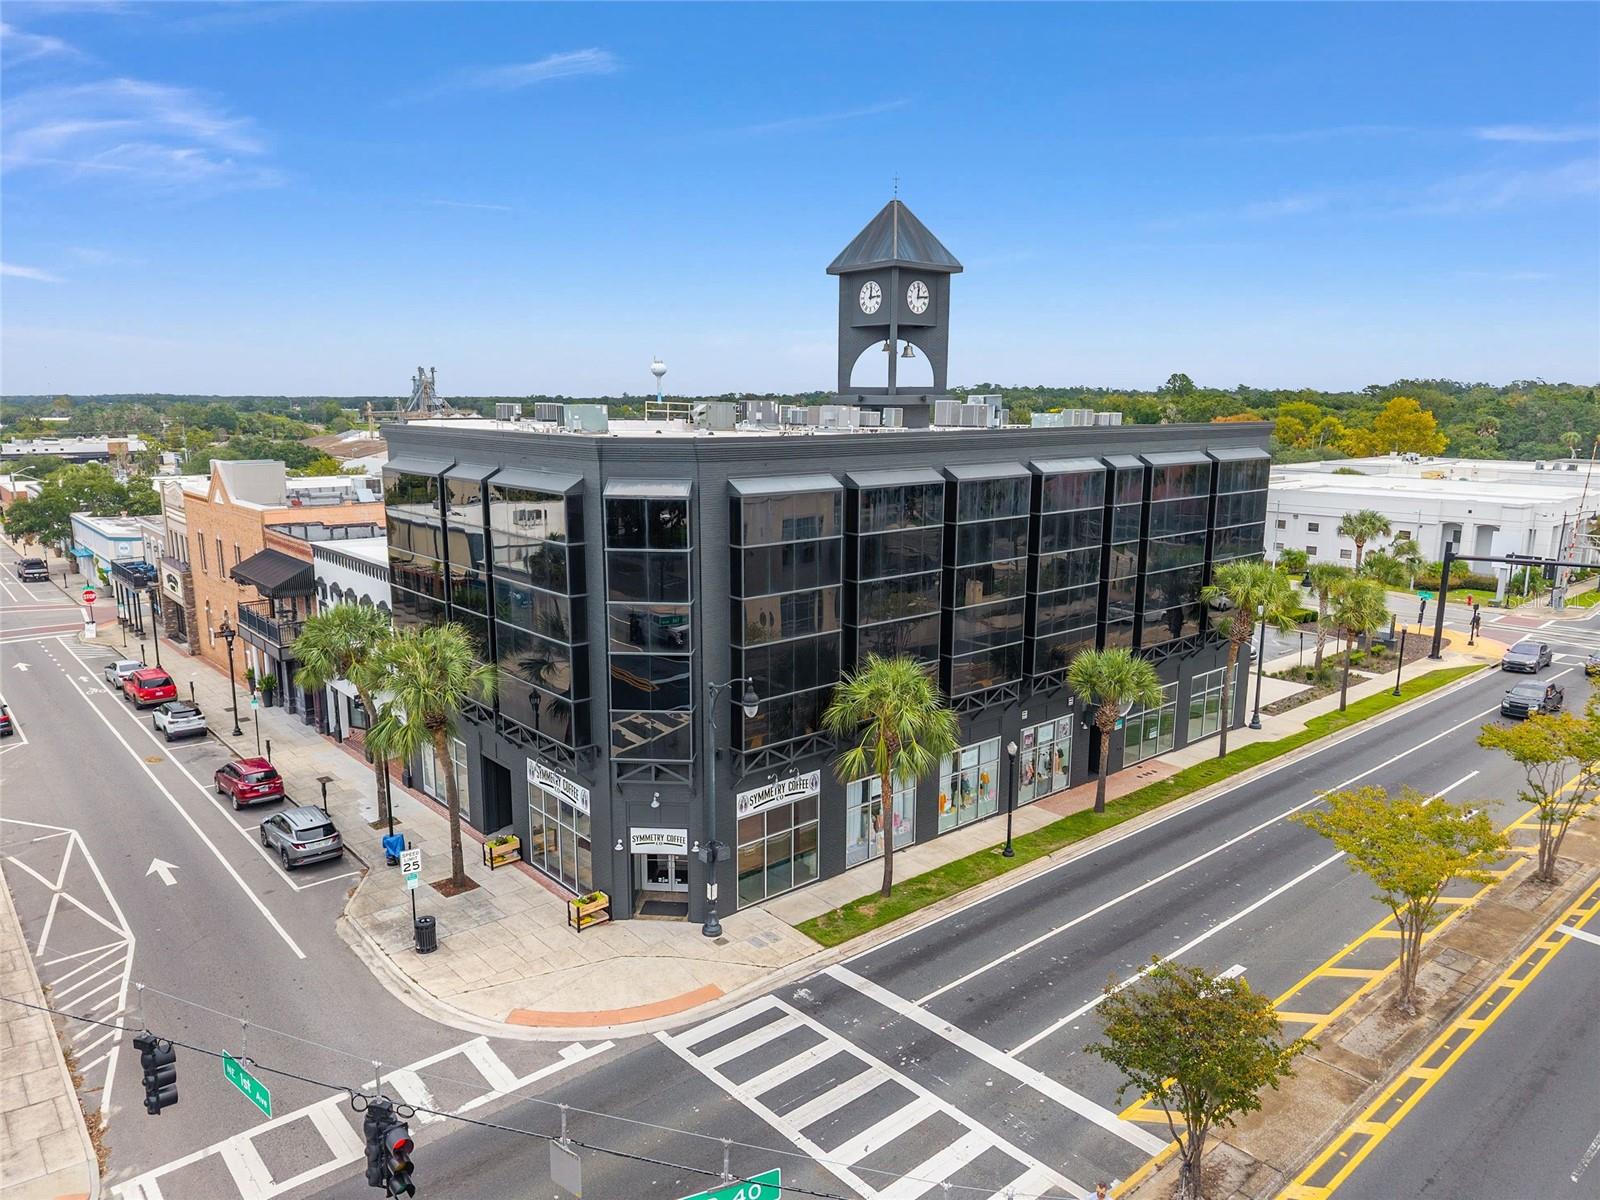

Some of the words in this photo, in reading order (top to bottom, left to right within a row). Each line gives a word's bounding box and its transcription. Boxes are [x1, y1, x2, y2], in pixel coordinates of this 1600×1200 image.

[535, 766, 561, 787] SYMMETRY
[563, 778, 579, 801] COFFEE
[749, 783, 786, 806] SYMMETRY
[788, 778, 809, 792] COFFEE
[631, 834, 664, 843] SYMMETRY
[666, 834, 686, 845] COFFEE
[404, 861, 420, 872] 25
[226, 1063, 236, 1079] NE
[239, 1072, 251, 1093] 1st
[255, 1091, 268, 1109] Ave
[732, 1183, 761, 1200] 40
